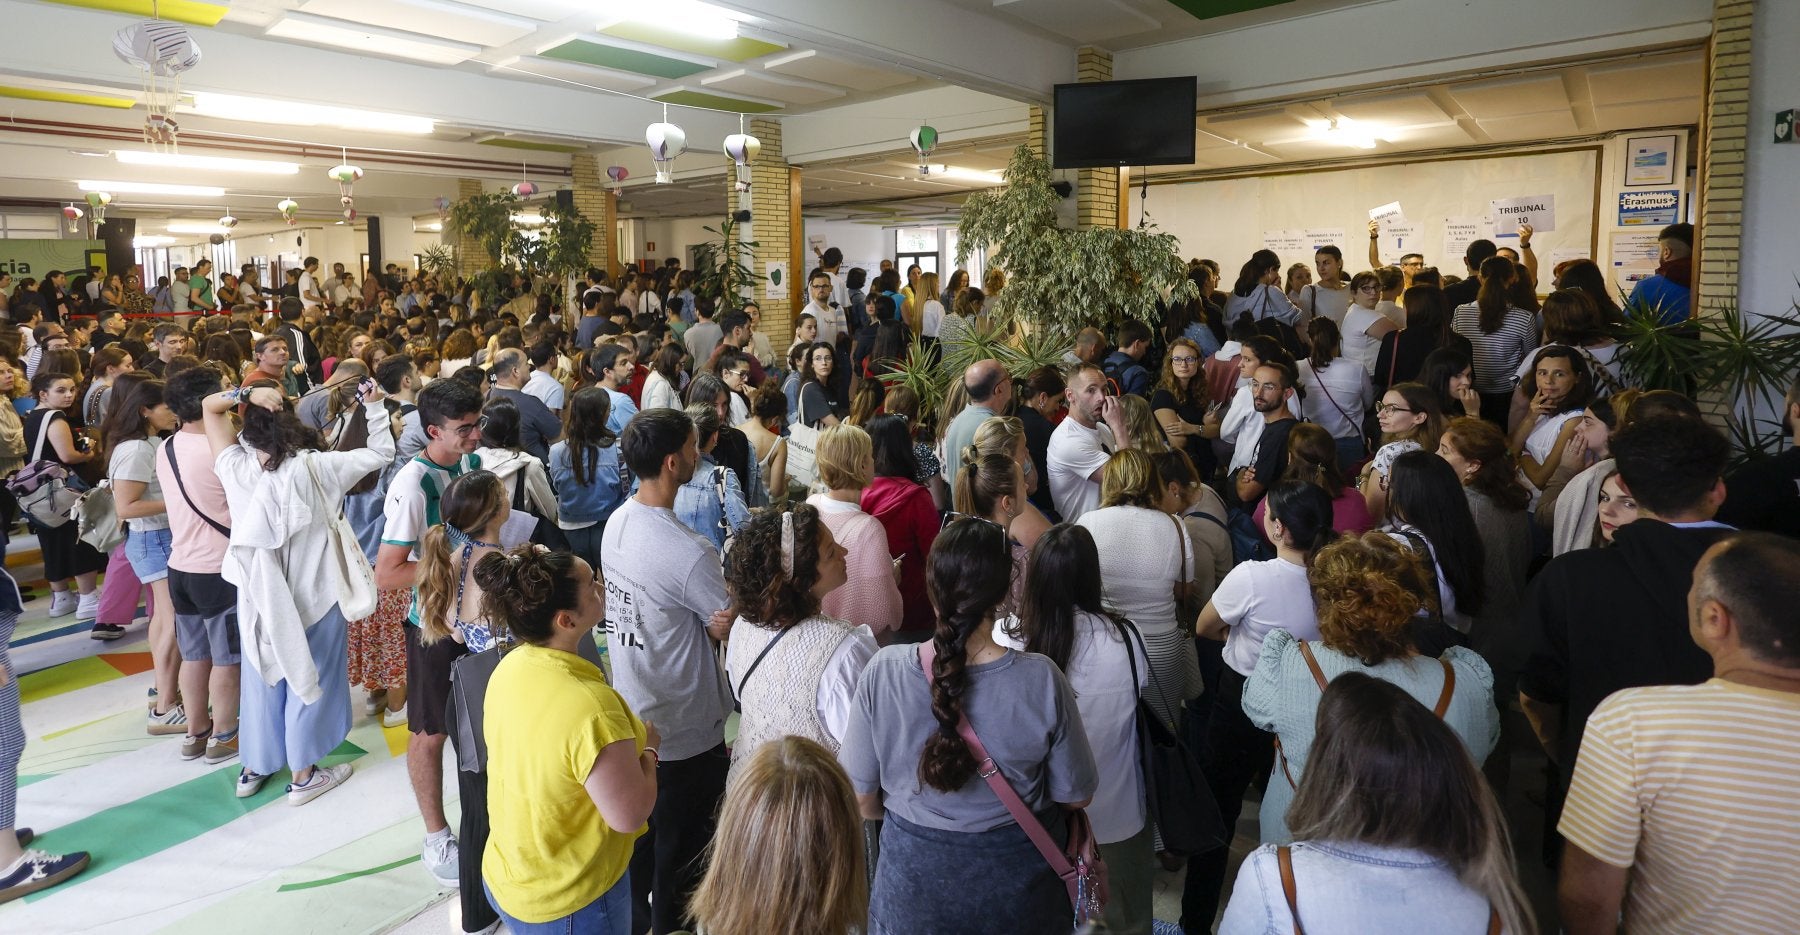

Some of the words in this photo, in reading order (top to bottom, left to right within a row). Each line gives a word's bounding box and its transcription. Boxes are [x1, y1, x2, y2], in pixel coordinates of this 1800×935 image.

[1624, 198, 1673, 206] Erasmus+
[1498, 204, 1546, 214] TRIBUNAL
[1374, 210, 1398, 220] TRIBUNAL
[605, 578, 632, 605] OSTE
